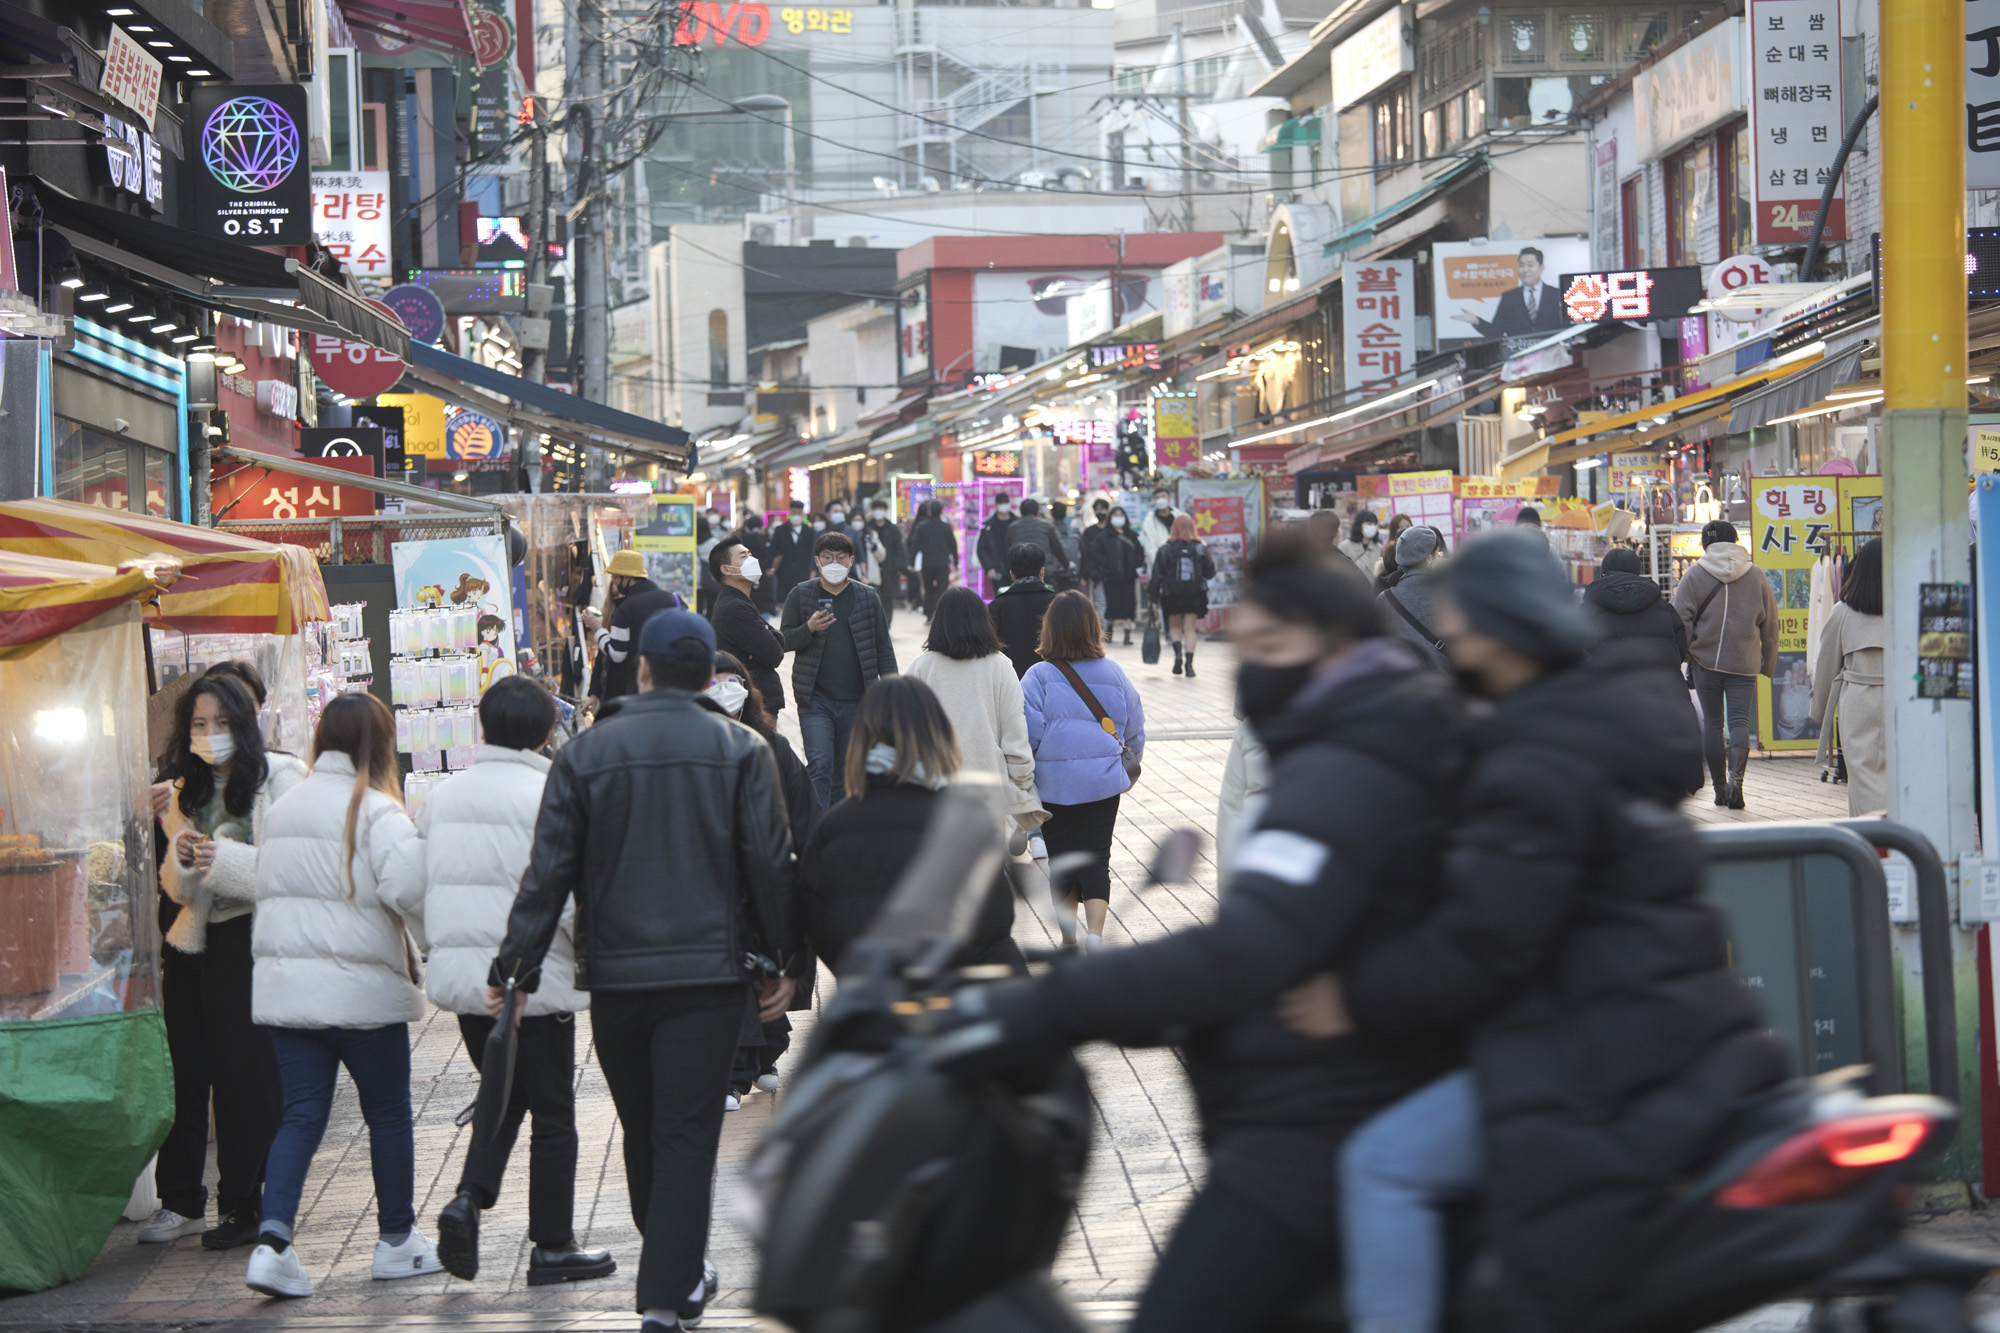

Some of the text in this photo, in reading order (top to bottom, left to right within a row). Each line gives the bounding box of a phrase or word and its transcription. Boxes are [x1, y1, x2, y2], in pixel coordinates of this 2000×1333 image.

[675, 1, 771, 48] DVD
[781, 8, 854, 35] 영화관
[1764, 84, 1832, 104] 뼈해장국
[223, 218, 284, 236] O.S.T
[1771, 204, 1812, 231] 24
[1801, 226, 1832, 237] On
[1721, 264, 1770, 315] 약
[406, 438, 440, 452] hool
[1760, 524, 1832, 555] 사주
